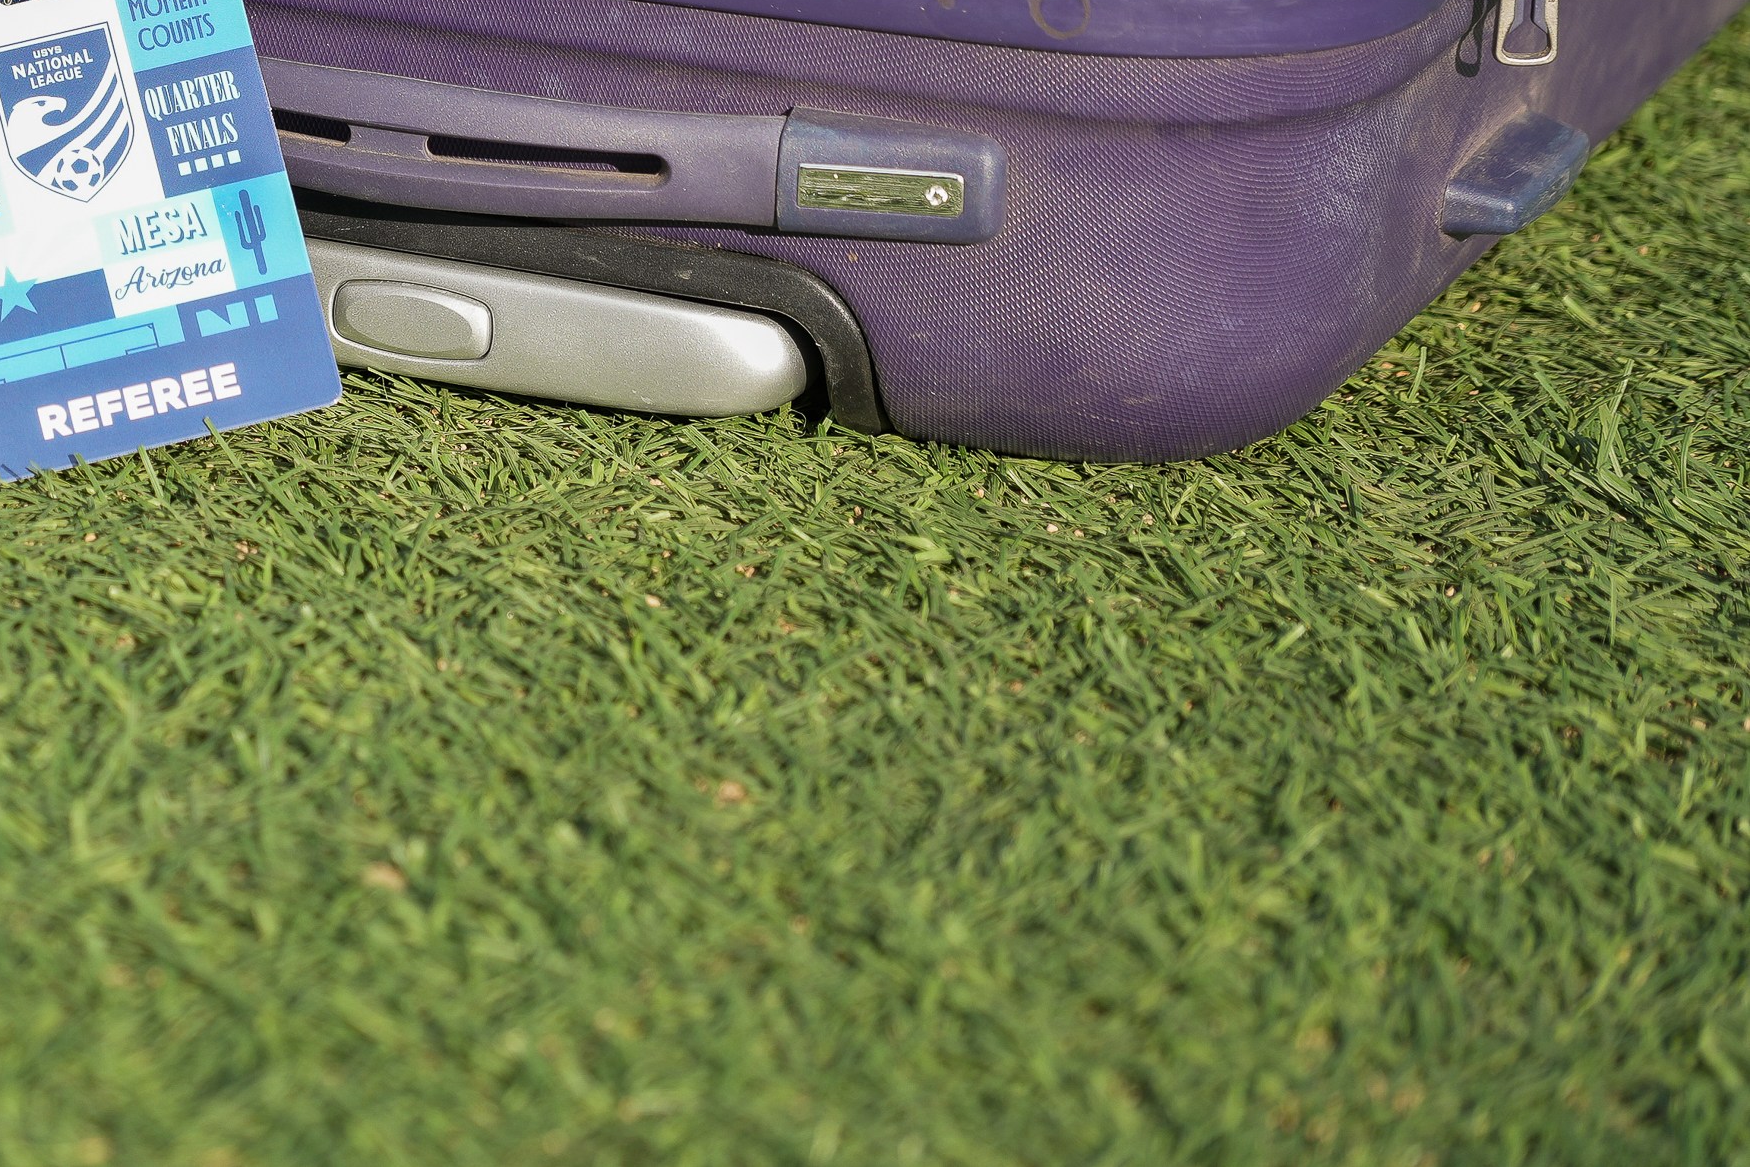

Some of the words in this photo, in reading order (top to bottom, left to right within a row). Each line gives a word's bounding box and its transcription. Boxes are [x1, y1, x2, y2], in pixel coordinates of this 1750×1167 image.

[32, 45, 63, 59] USYS
[137, 13, 216, 51] COUNTS
[11, 48, 94, 80] NATIONAL
[29, 66, 83, 89] LEAGUE
[144, 70, 241, 121] QUARTER
[165, 112, 239, 157] FINALS
[115, 202, 208, 256] MESA
[115, 258, 227, 300] Arizona
[37, 362, 242, 441] REFEREE
